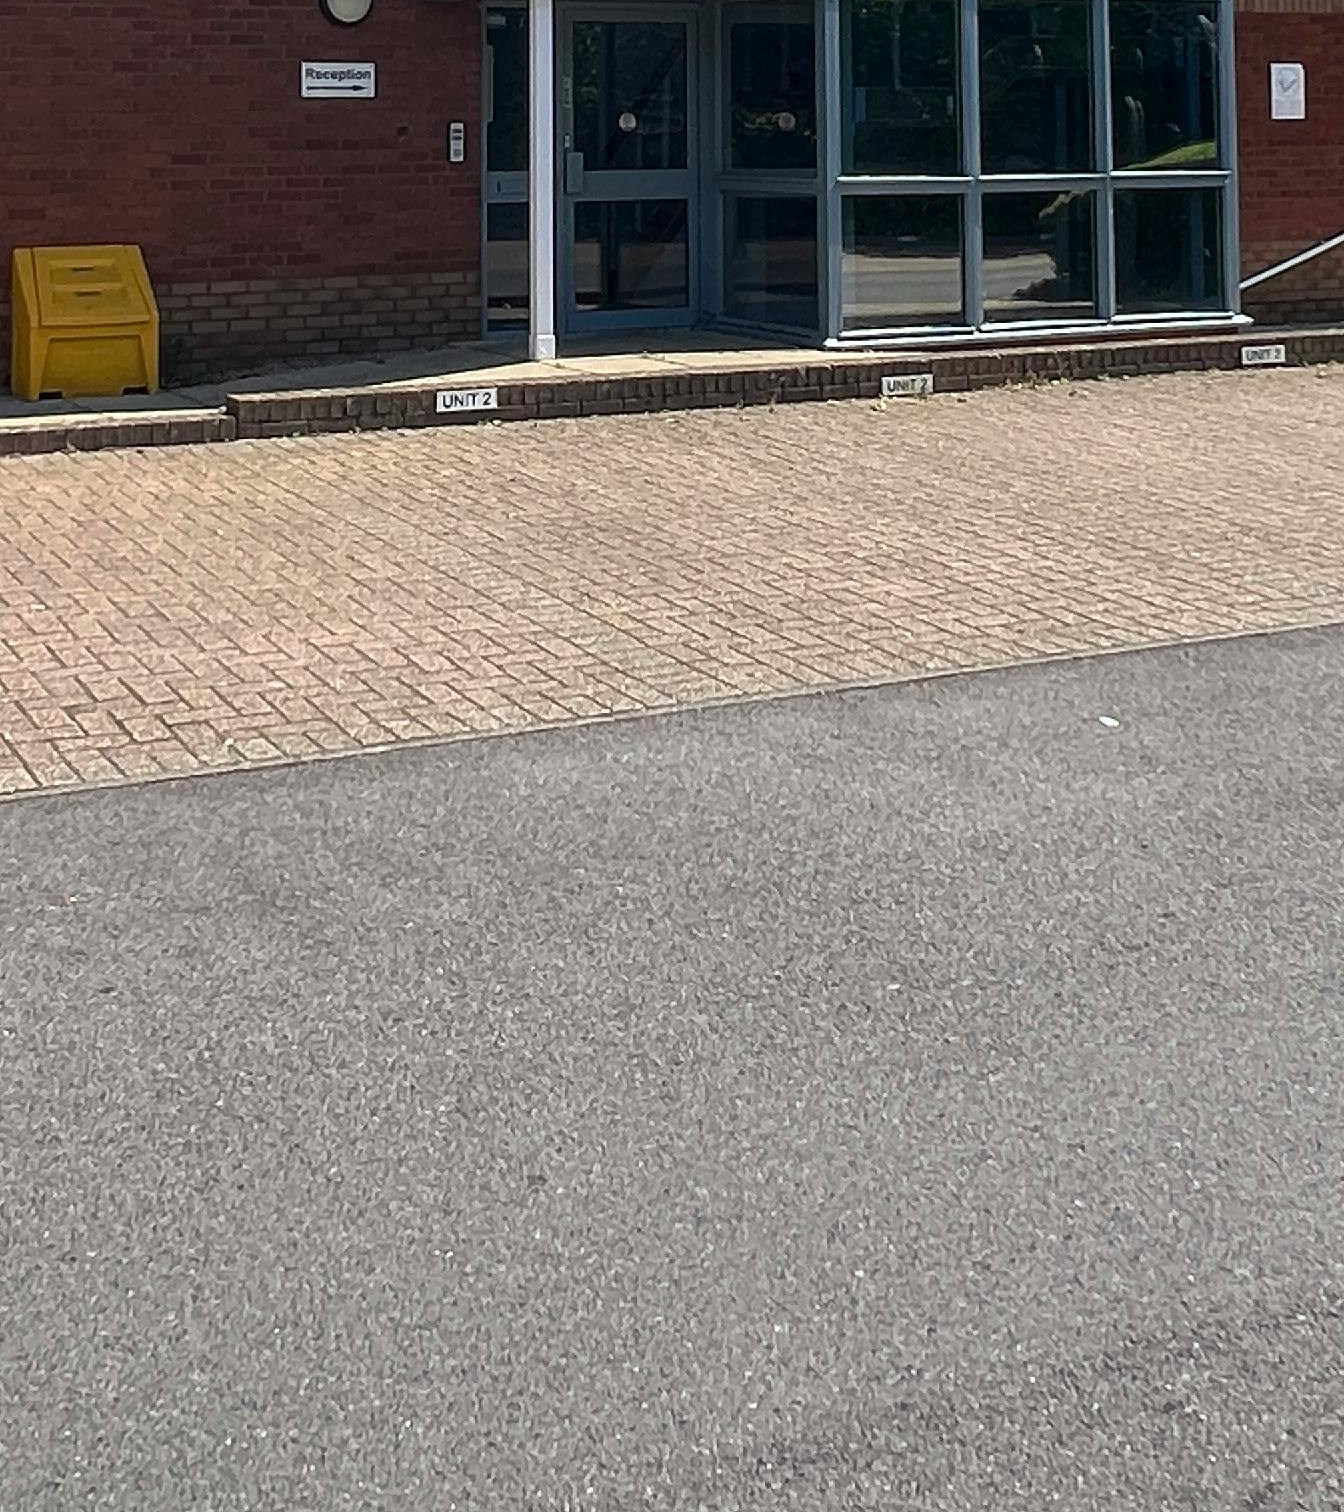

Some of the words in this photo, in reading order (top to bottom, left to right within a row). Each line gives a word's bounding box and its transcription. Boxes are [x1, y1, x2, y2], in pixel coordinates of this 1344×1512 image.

[305, 68, 371, 82] Reception
[887, 378, 917, 392] UNIT
[442, 393, 479, 409] UNIT
[482, 392, 492, 406] 2
